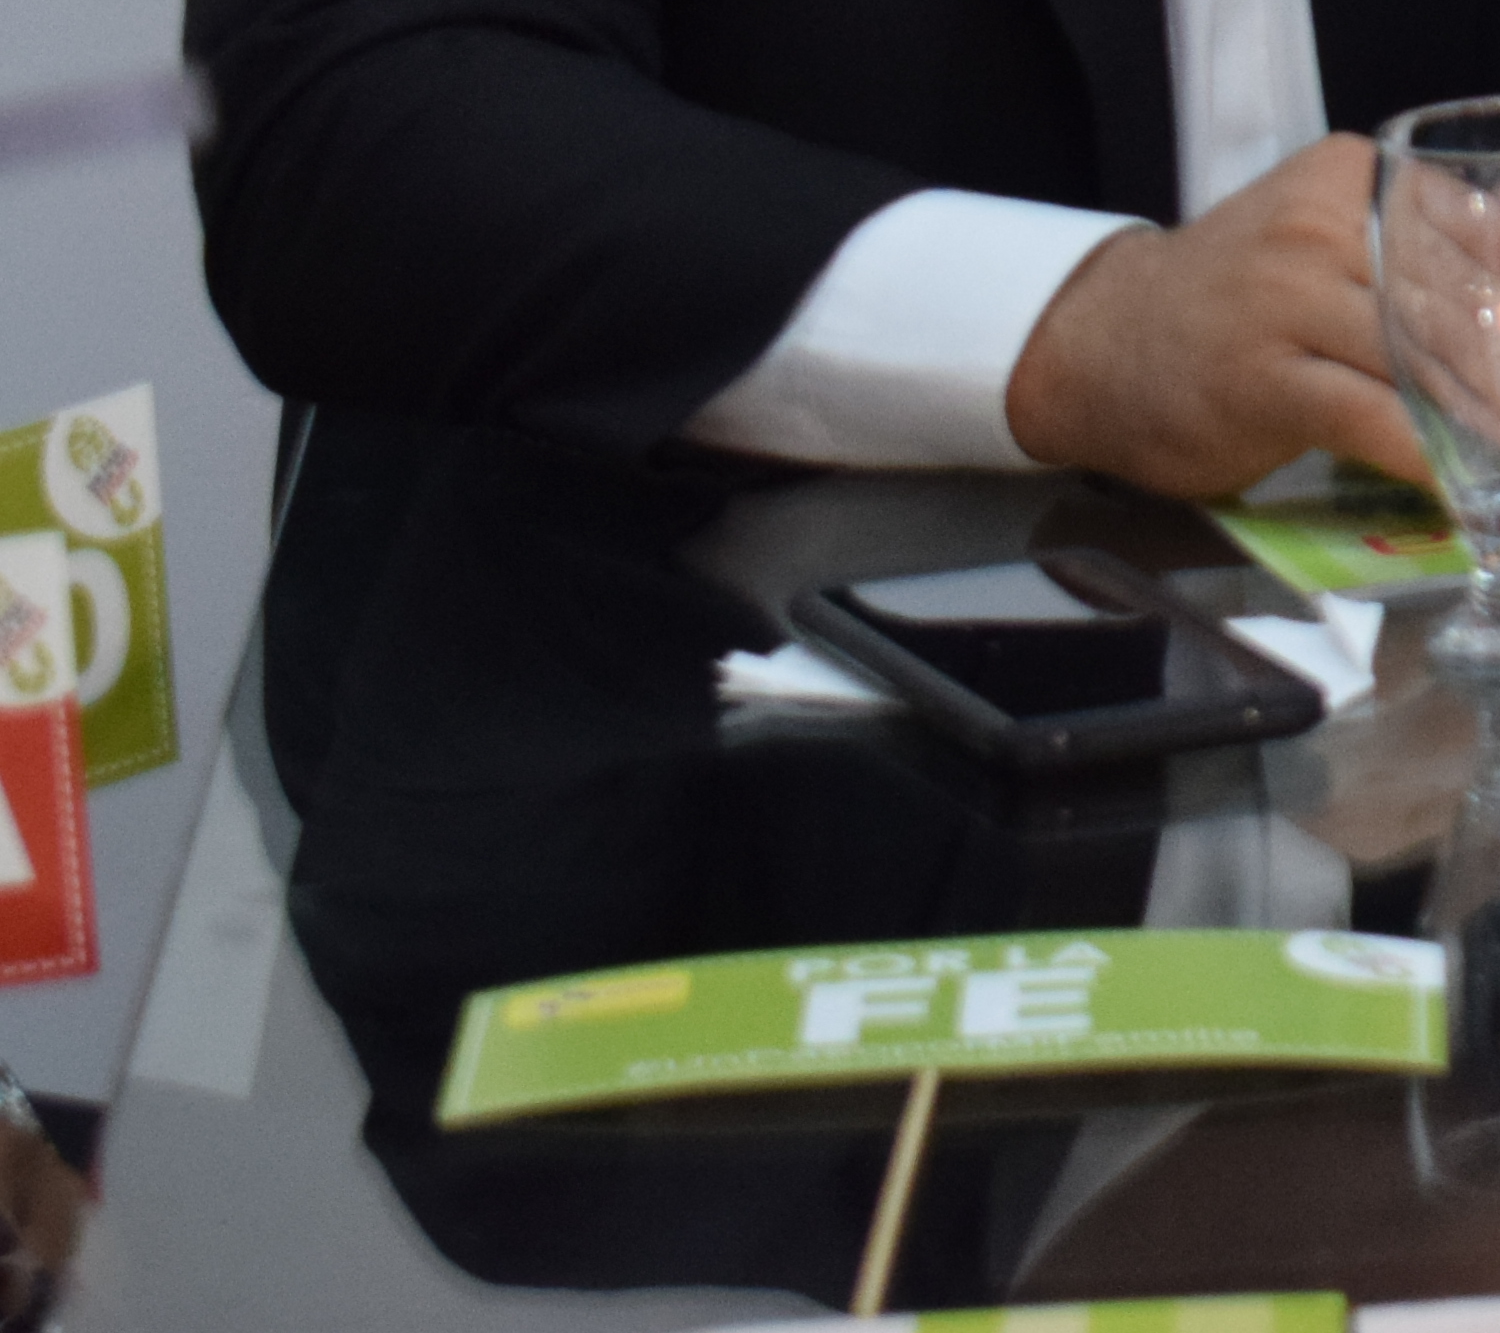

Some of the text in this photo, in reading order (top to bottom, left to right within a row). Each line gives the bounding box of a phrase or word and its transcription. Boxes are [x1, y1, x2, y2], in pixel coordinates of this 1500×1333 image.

[788, 939, 1113, 983] POR LA
[799, 966, 1098, 1047] FE
